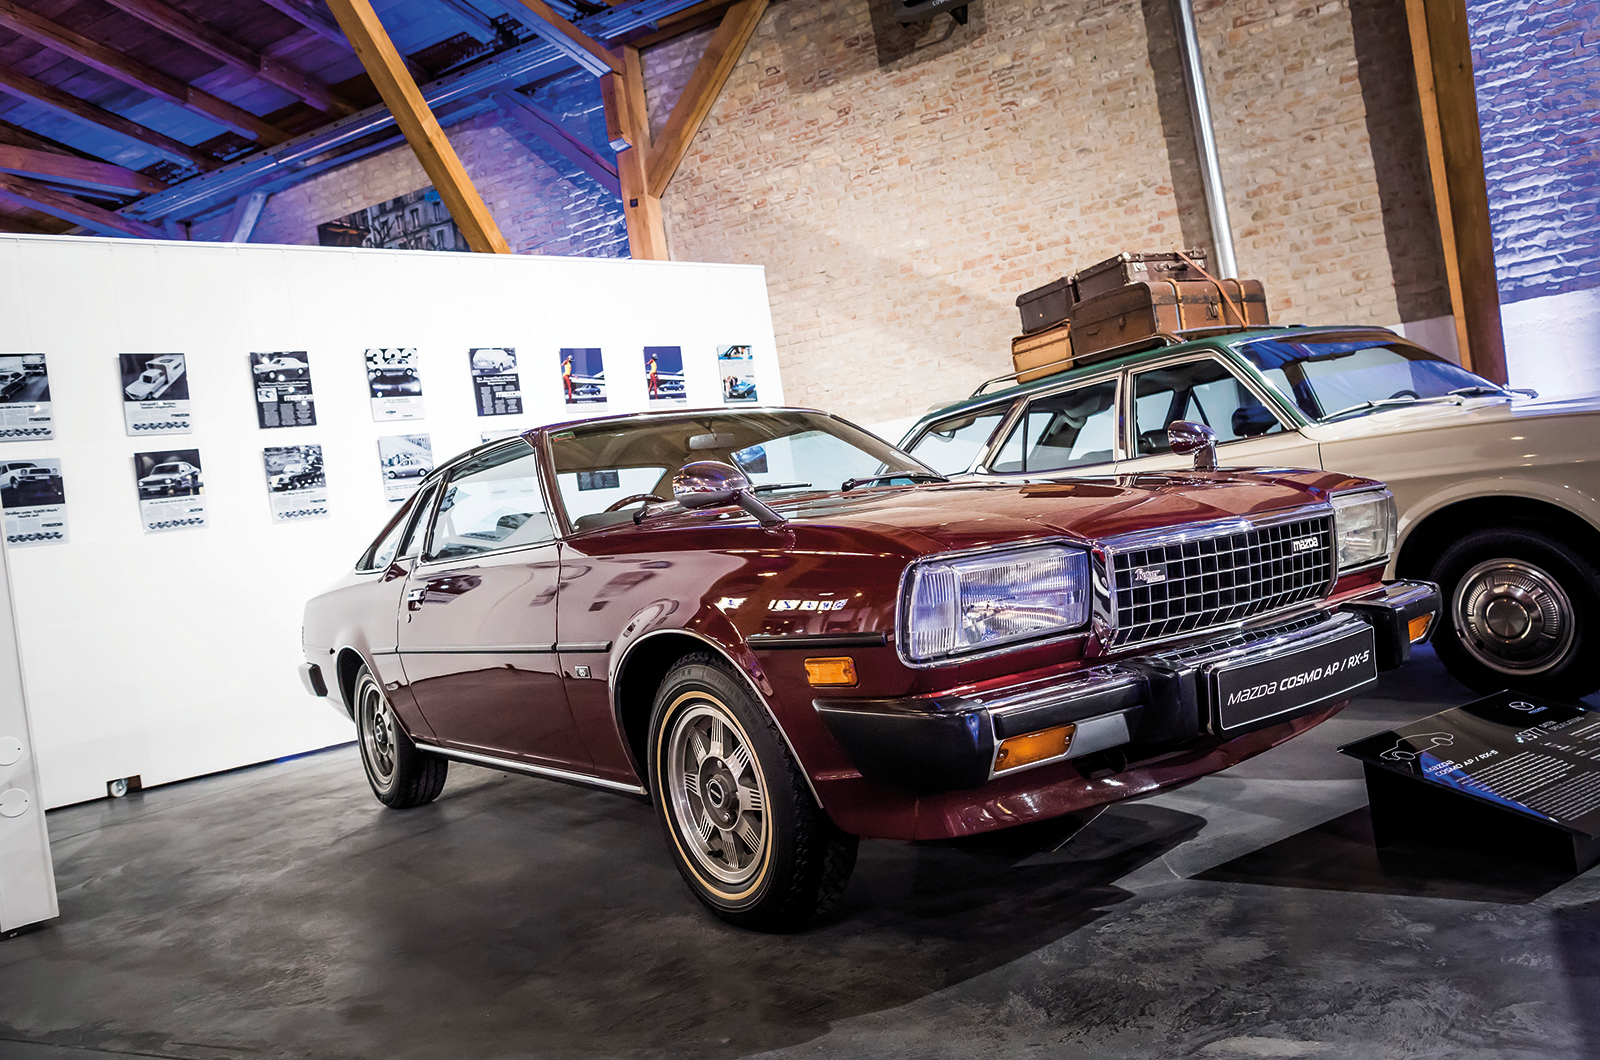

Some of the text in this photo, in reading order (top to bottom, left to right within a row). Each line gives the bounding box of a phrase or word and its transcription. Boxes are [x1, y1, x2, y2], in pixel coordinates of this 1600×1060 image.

[1293, 536, 1318, 552] mazda
[1279, 667, 1322, 692] COSMO
[1323, 661, 1339, 678] AP
[1340, 659, 1347, 672] /
[1347, 649, 1370, 669] RX-5
[1435, 763, 1463, 777] COSMO
[1463, 758, 1474, 767] AP
[1479, 749, 1499, 760] RX-5
